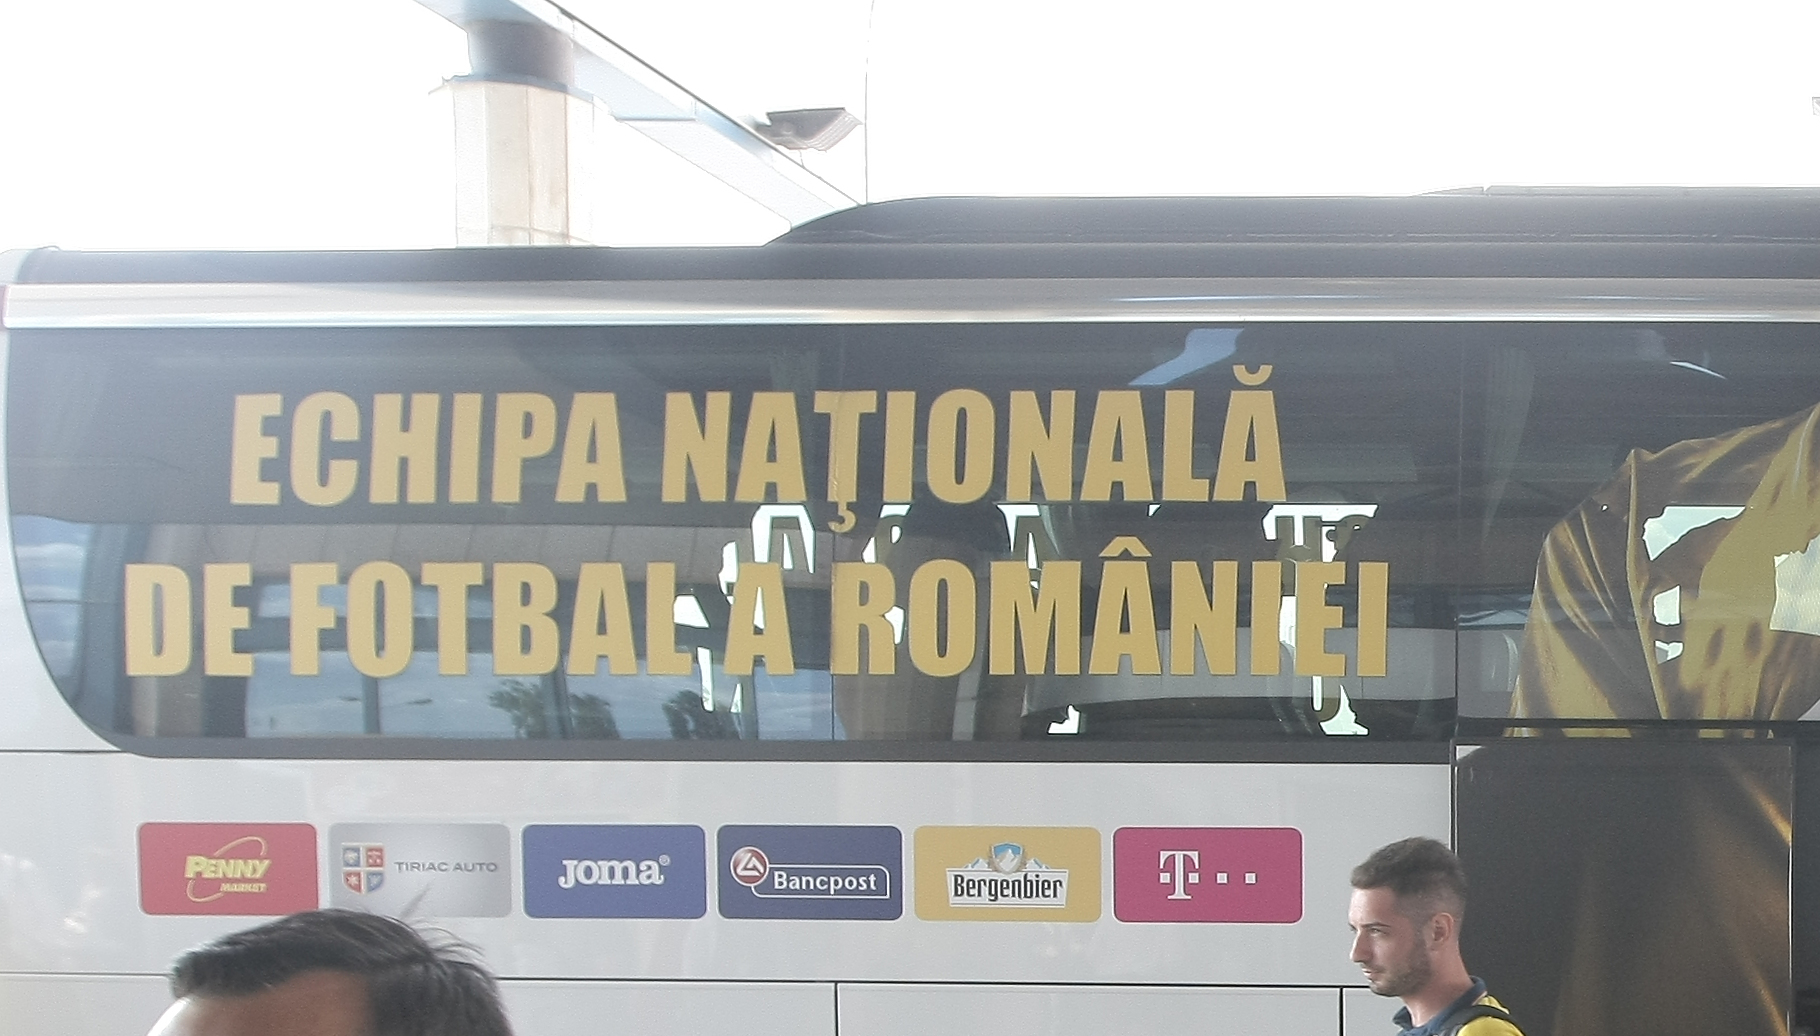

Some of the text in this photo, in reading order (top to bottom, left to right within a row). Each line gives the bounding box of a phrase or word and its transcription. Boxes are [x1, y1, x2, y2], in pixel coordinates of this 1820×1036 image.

[230, 391, 627, 506] ECHIPA
[125, 536, 1390, 679] DE FOTBAL A ROMÂNIEI
[394, 861, 498, 873] TIRIAC AUTO
[773, 870, 877, 895] Bancpost
[952, 873, 1064, 902] Bergenbier
